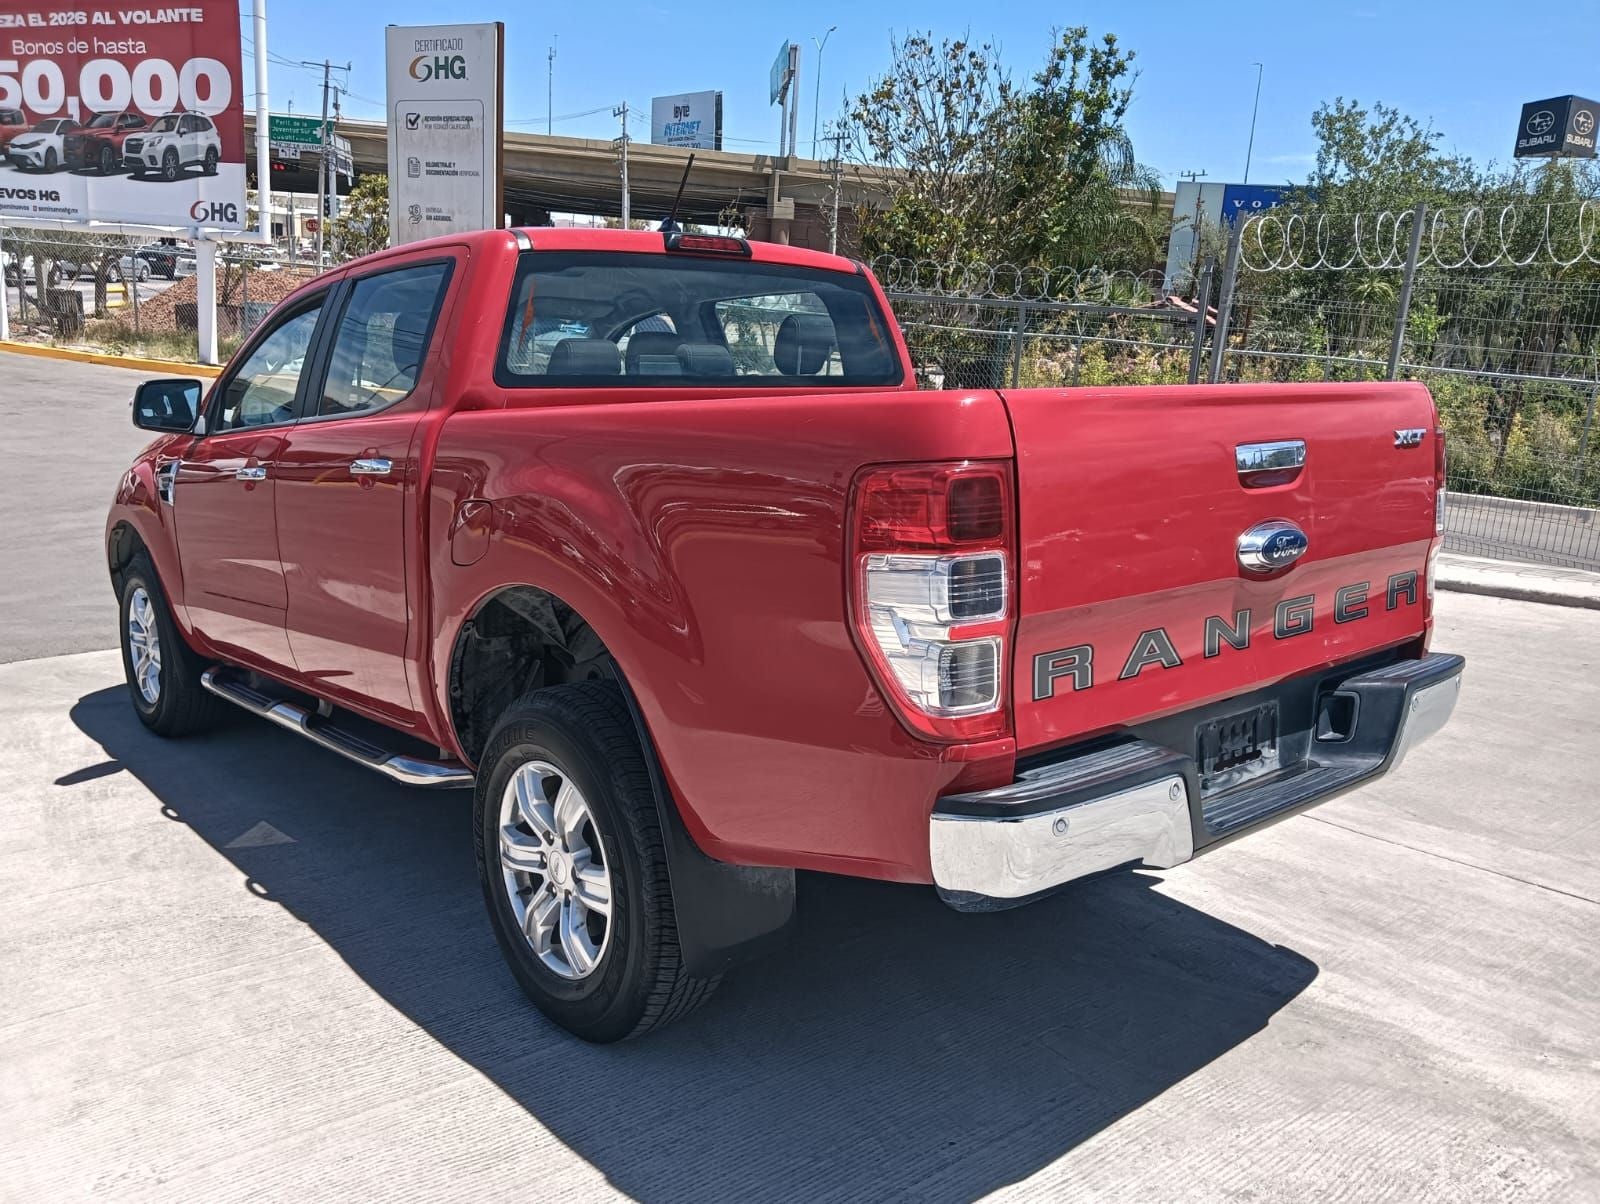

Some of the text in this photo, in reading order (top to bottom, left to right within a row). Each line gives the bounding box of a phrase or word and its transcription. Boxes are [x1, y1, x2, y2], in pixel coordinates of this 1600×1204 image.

[28, 13, 47, 27] EL
[49, 11, 88, 26] 2026
[92, 11, 116, 25] AL
[119, 8, 204, 25] VOLANTE
[12, 36, 147, 55] Bonos de hasta
[415, 38, 463, 52] CERTIFICADO
[434, 55, 466, 80] HG
[1518, 134, 1556, 148] SUBARU
[1566, 133, 1593, 148] SUBARU
[210, 203, 238, 223] HG
[1393, 428, 1427, 446] XLT
[1273, 535, 1300, 558] Ford
[1032, 570, 1418, 702] RANGER
